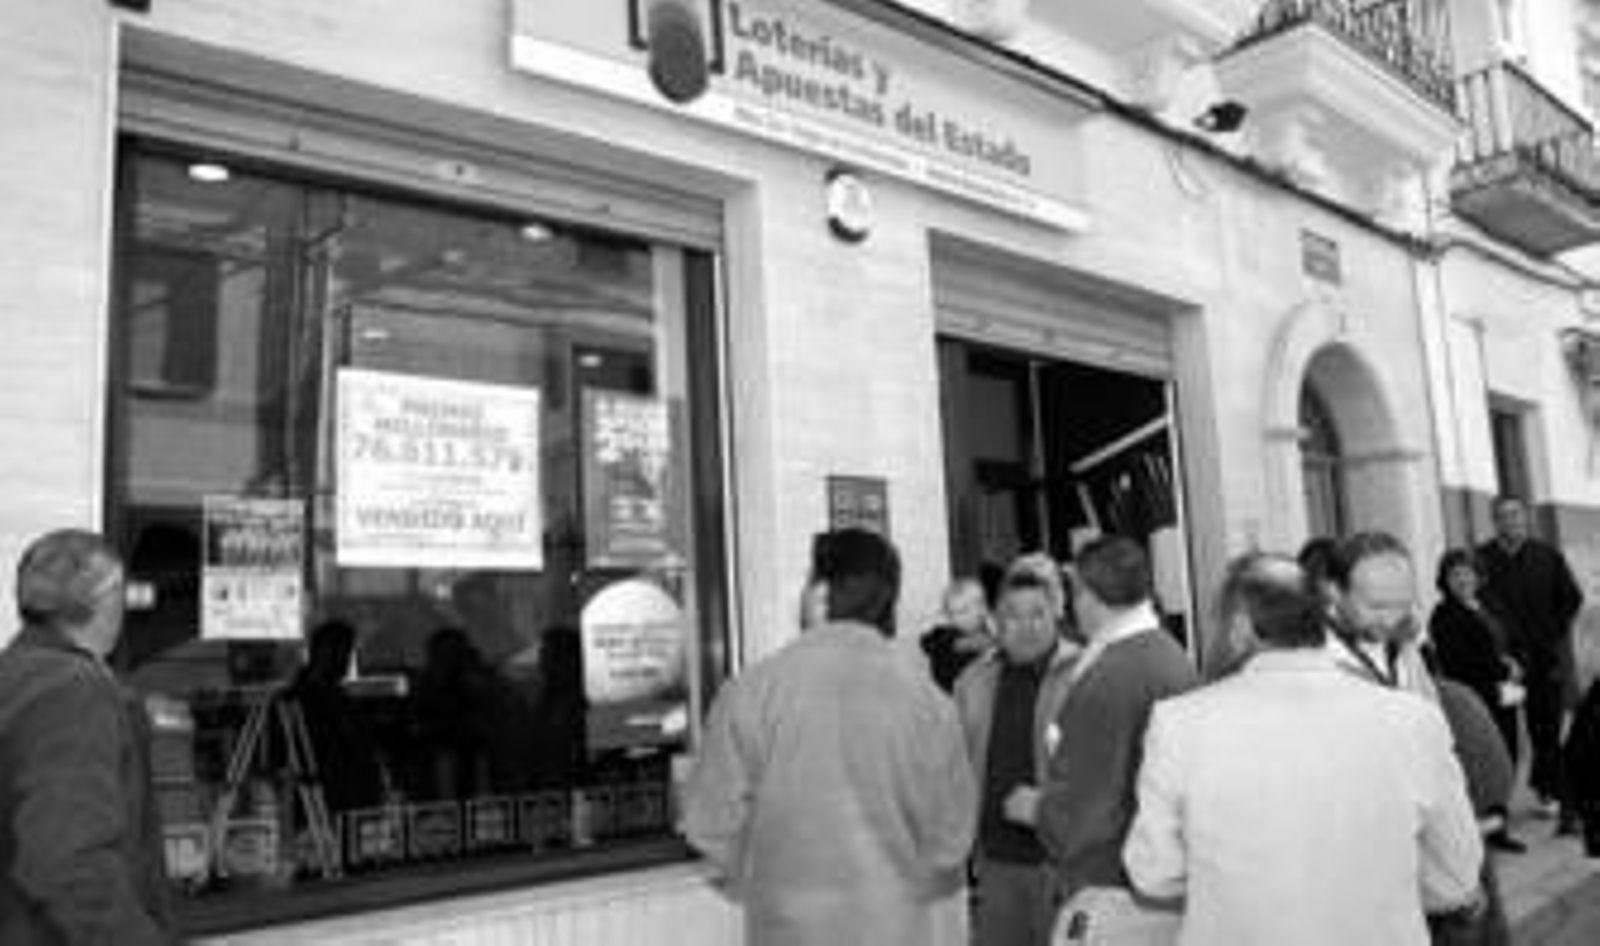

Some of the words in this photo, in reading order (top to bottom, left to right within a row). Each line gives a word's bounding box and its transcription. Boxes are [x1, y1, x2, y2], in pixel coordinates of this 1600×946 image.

[736, 50, 884, 127] Apuestas
[895, 101, 935, 142] del
[943, 119, 1031, 176] Estado
[872, 60, 889, 95] y
